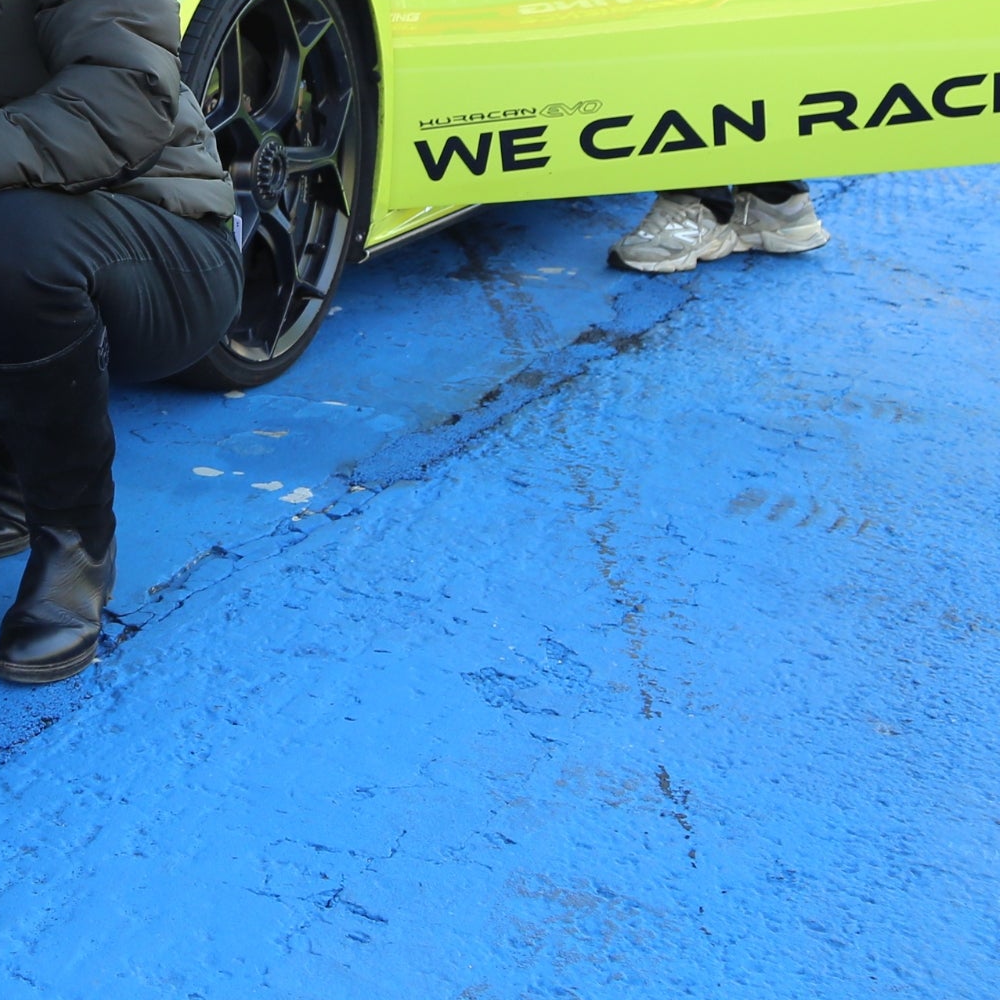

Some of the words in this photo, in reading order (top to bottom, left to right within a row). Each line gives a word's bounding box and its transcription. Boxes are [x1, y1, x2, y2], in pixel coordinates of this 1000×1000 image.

[414, 125, 551, 181] WE
[579, 99, 766, 160] CAN
[798, 72, 1000, 136] RAC
[539, 100, 603, 117] EVO
